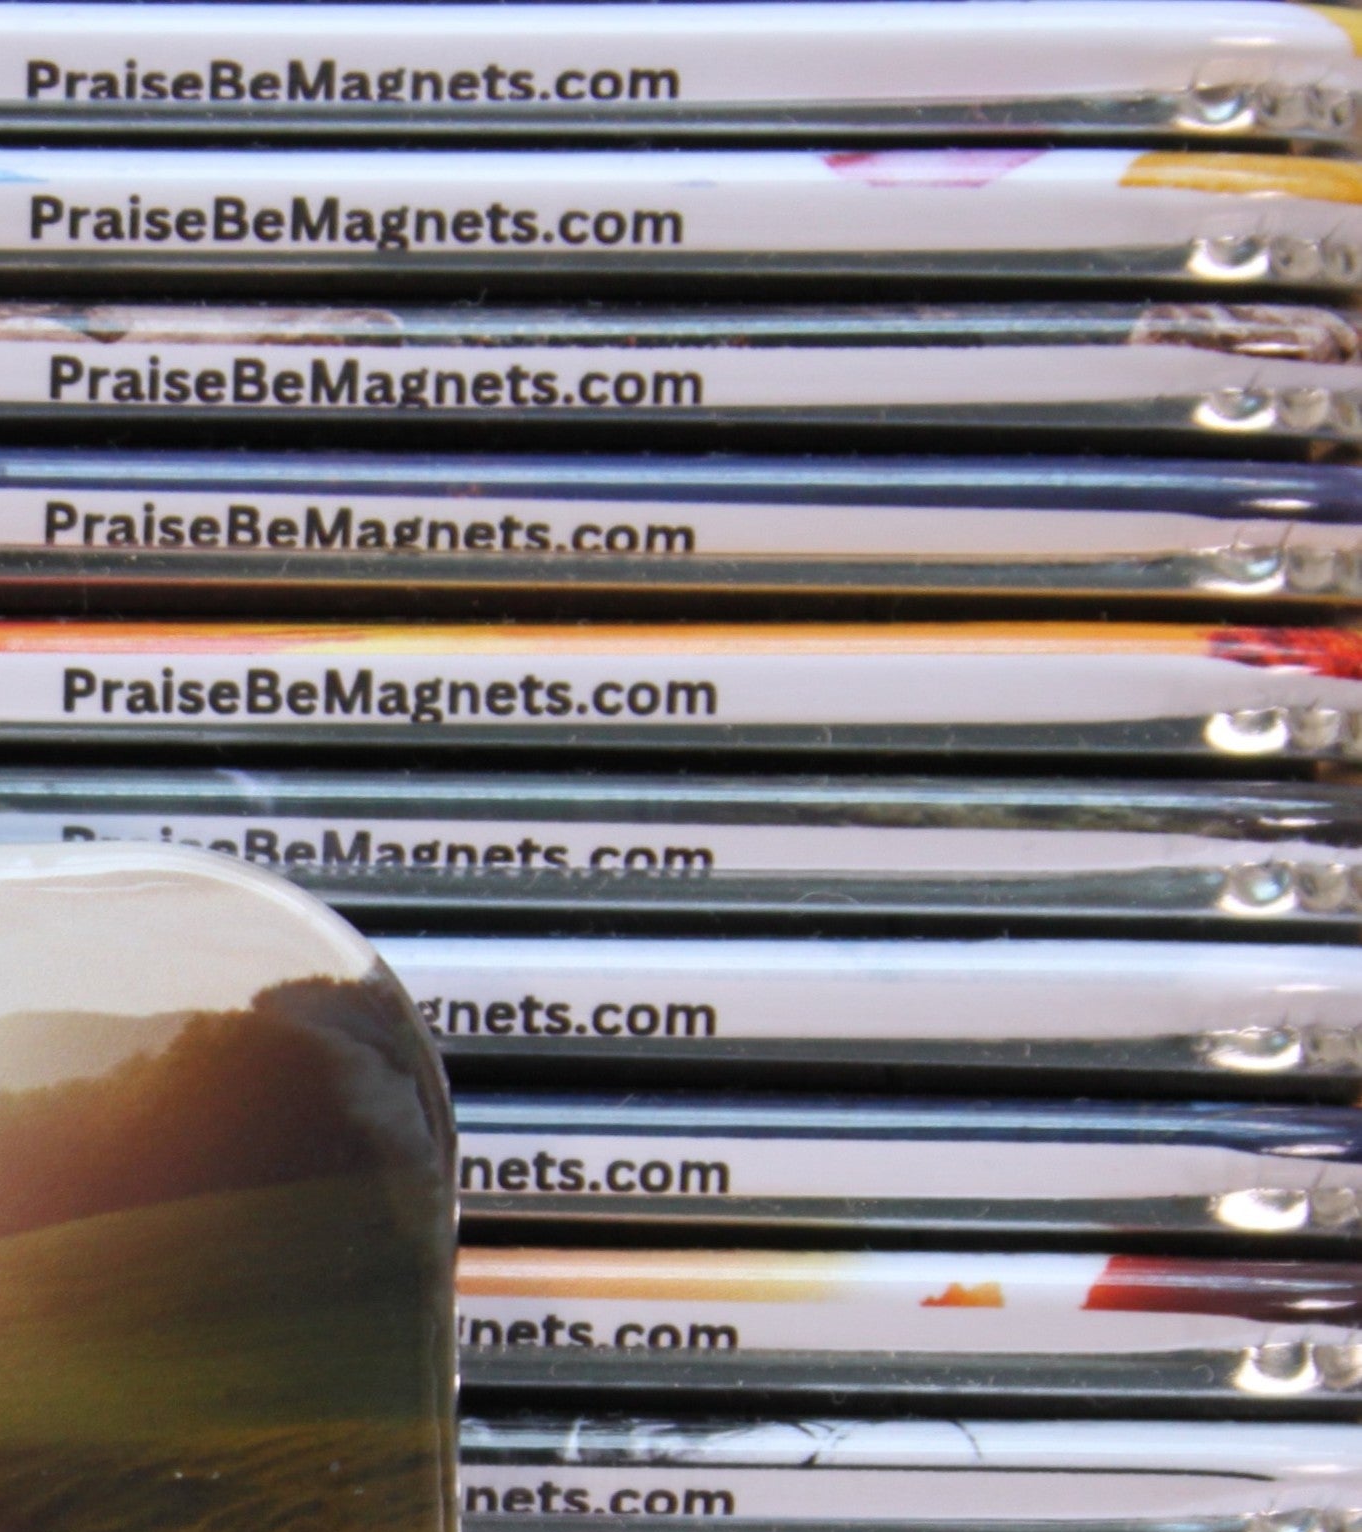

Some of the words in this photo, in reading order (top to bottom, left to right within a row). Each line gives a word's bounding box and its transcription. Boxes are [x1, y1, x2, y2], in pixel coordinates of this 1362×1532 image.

[27, 60, 680, 101] PraiseBeMagnets.com
[30, 195, 683, 251] PraiseBeMagnets.com
[49, 356, 702, 408] PraiseBeMagnets.com
[45, 501, 695, 553] PraiseBeMagnets.com
[63, 668, 717, 723] PraiseBeMagnets.com
